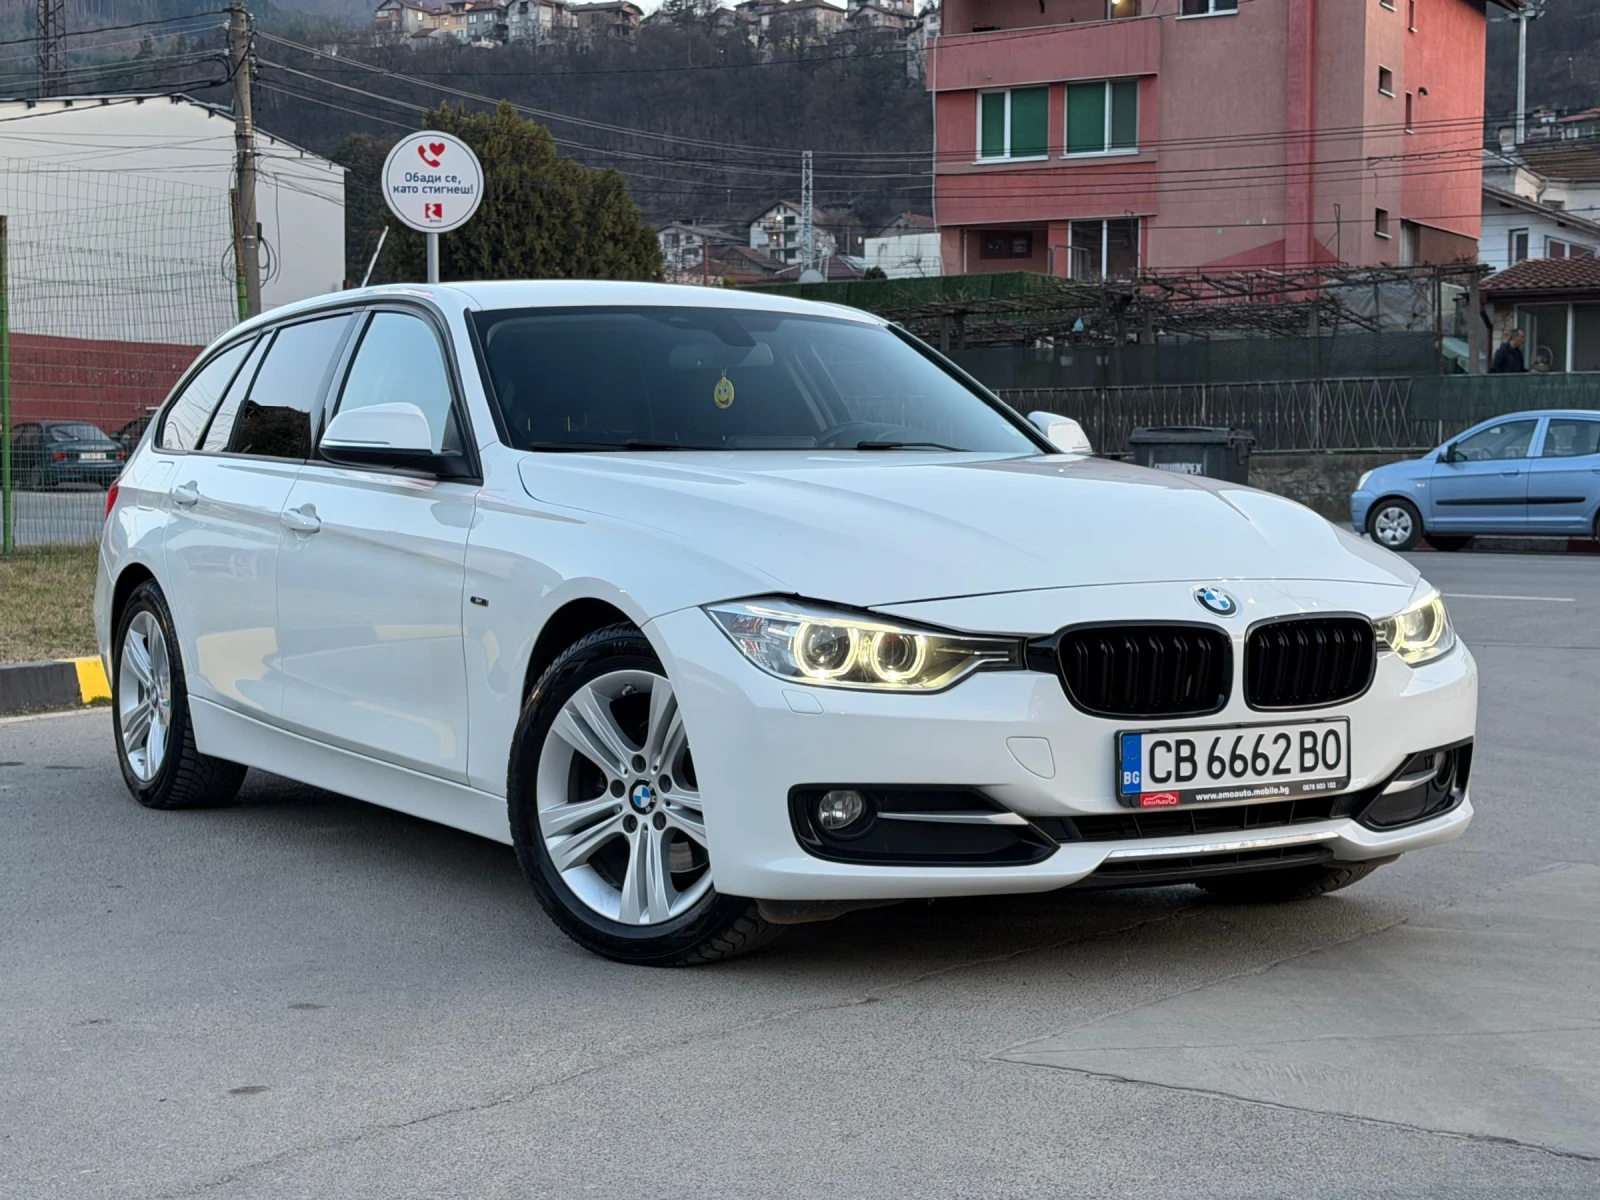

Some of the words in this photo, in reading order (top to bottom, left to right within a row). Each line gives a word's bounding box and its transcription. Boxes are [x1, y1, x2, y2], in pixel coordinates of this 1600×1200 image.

[405, 172, 441, 184] Обади
[445, 175, 461, 185] се,
[393, 185, 419, 194] като
[422, 184, 474, 195] стигнеш!
[1149, 738, 1198, 784] CB
[1207, 732, 1292, 780] 6662
[1123, 771, 1140, 785] BG
[1195, 785, 1290, 801] www.emoauto.mobile.bg
